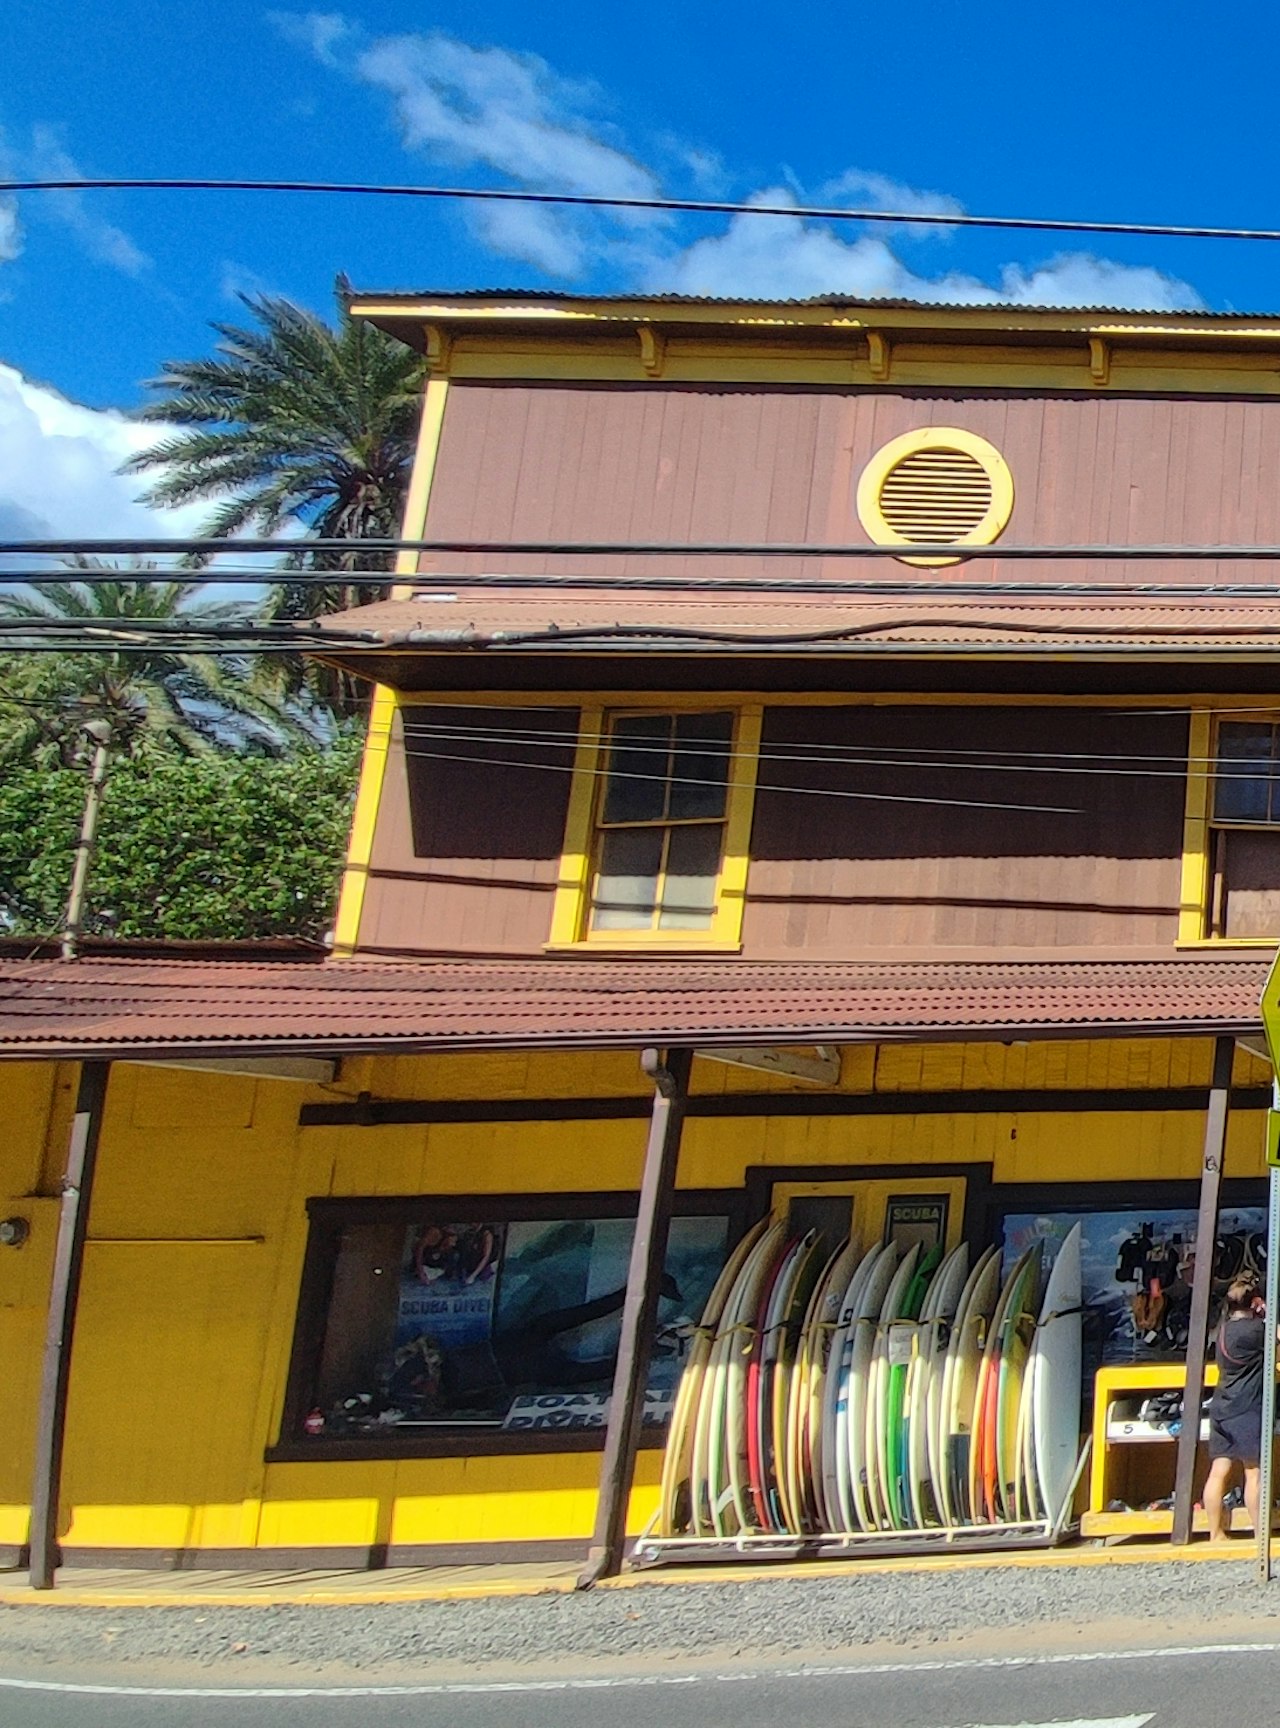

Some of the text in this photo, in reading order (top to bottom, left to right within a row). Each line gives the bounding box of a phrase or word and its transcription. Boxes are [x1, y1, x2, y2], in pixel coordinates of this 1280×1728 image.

[893, 1207, 939, 1220] SCUBA
[401, 1300, 448, 1315] SCUBA
[1124, 1424, 1134, 1434] 5
